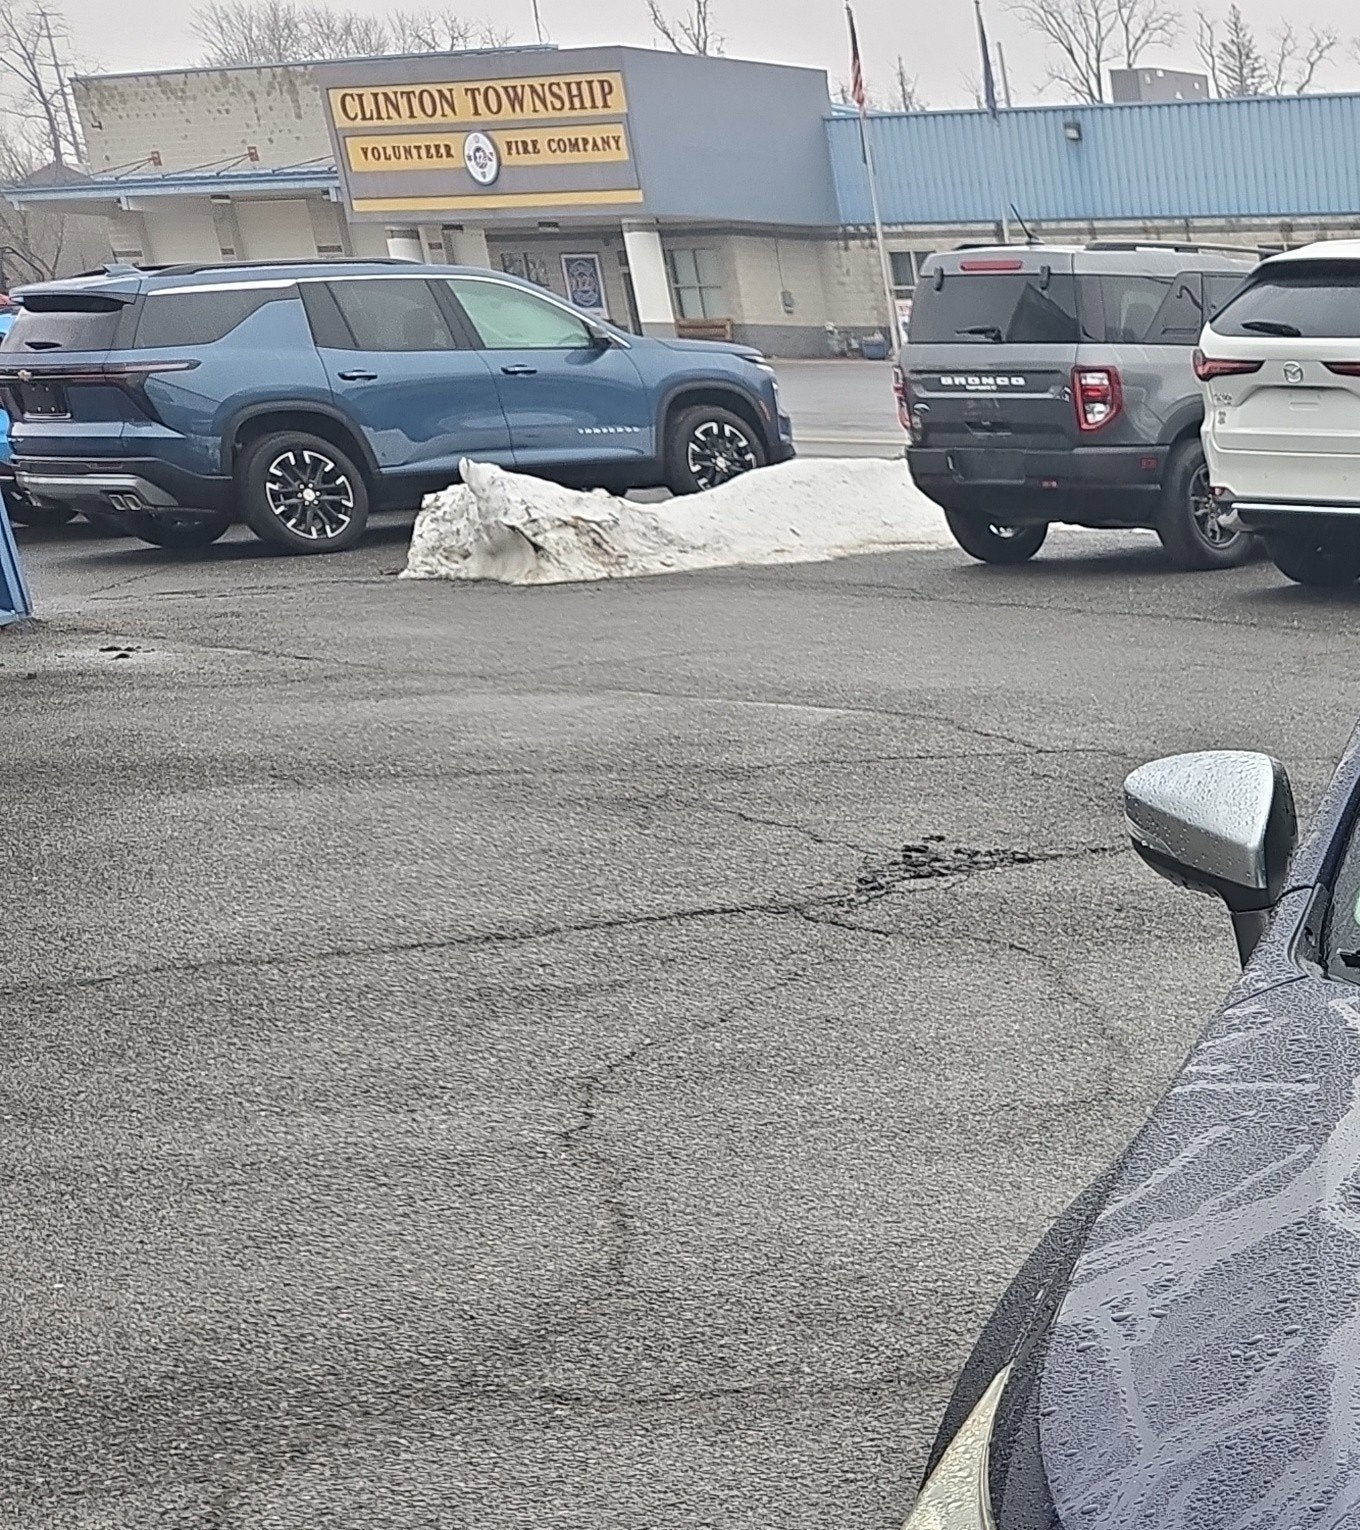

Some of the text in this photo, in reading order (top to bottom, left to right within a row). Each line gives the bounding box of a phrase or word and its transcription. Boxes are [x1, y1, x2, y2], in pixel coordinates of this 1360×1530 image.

[340, 78, 614, 121] CLINTON TOWNSHIP
[360, 143, 455, 161] VOLUNTEER
[505, 139, 541, 156] FIRE
[547, 135, 622, 154] COMPANY
[940, 376, 1026, 386] BRONCO
